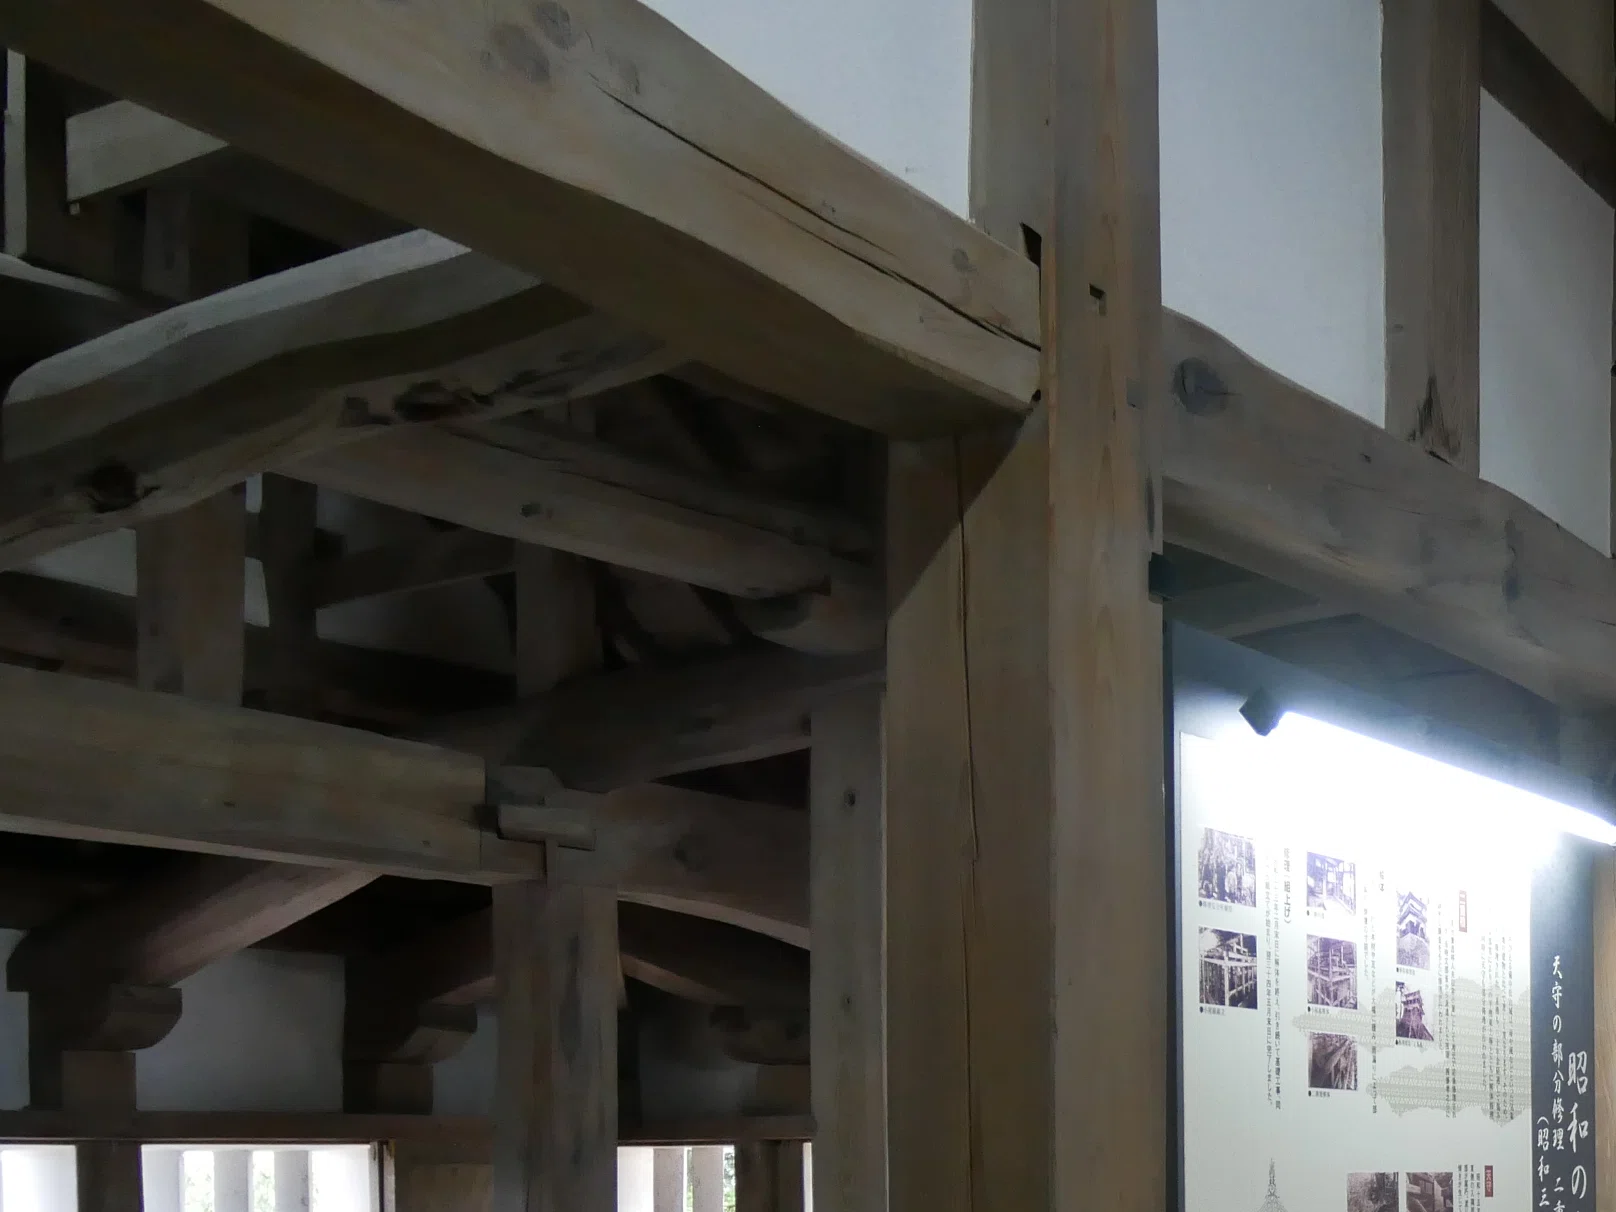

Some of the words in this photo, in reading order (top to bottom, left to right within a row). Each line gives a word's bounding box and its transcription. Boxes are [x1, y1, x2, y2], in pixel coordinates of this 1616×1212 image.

[1551, 955, 1565, 1151] 天守の部分修理
